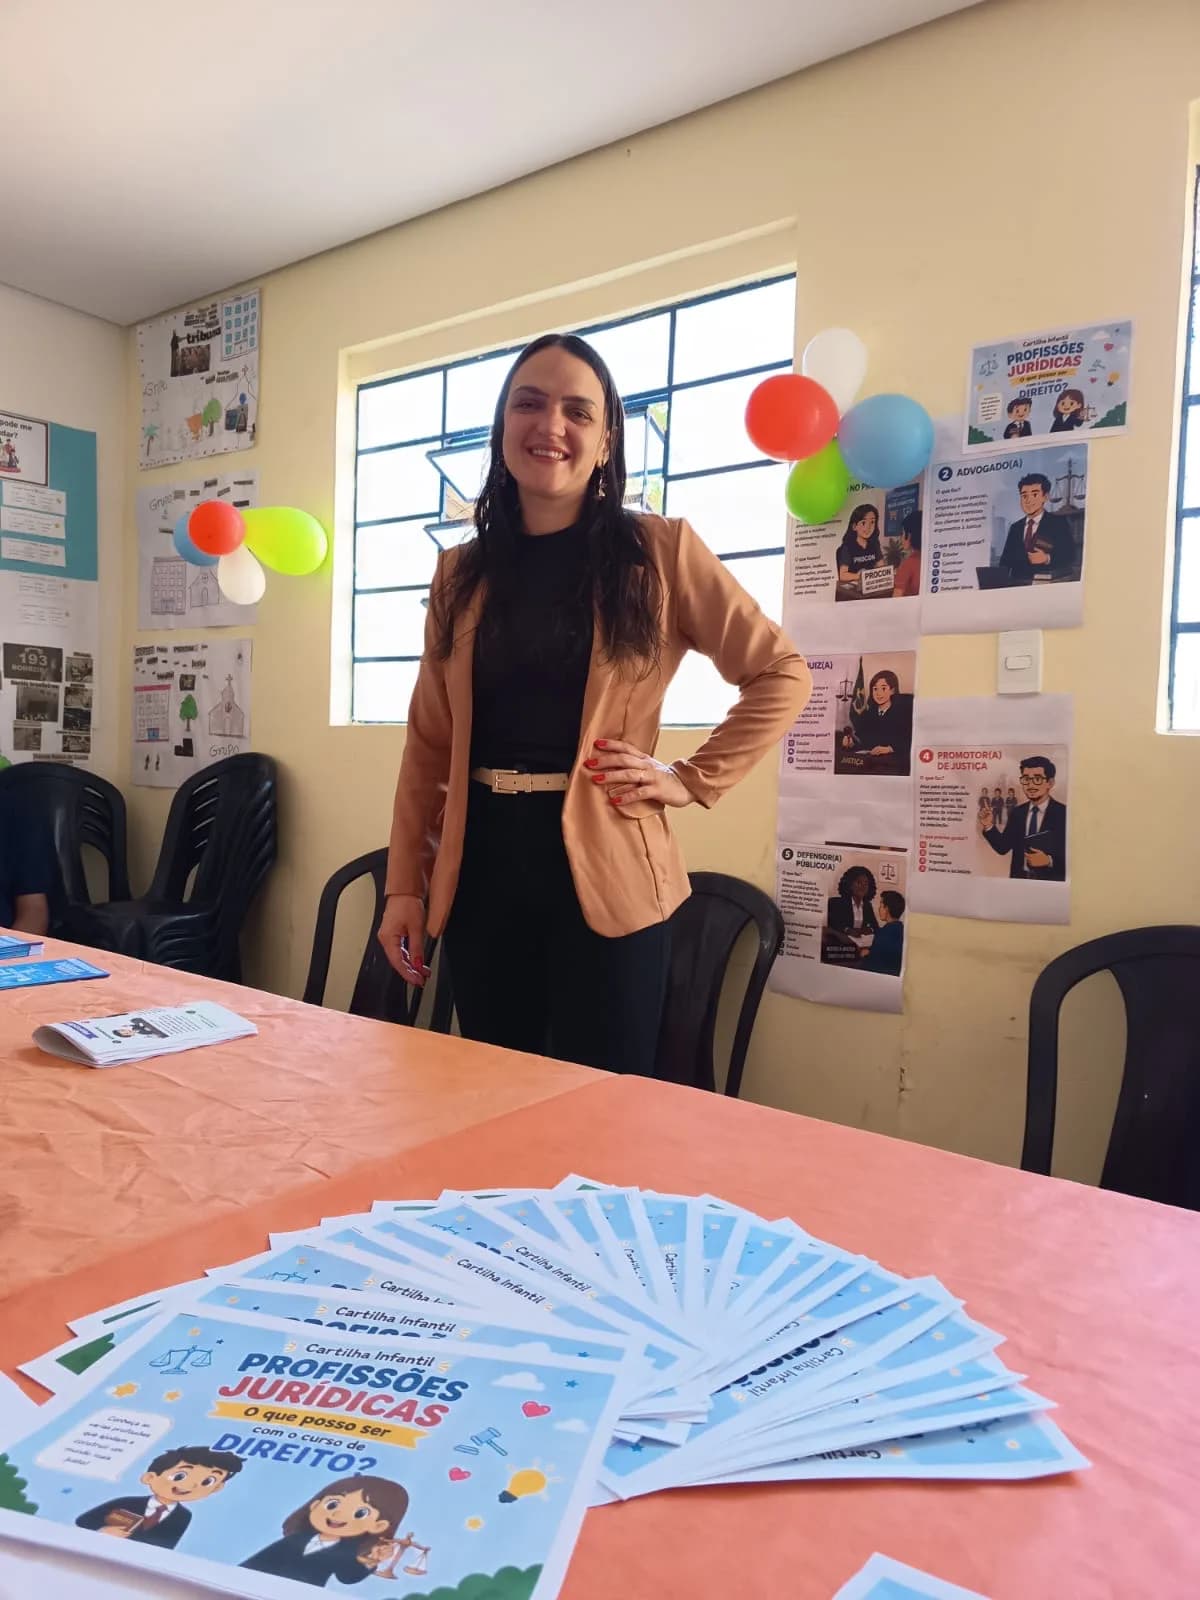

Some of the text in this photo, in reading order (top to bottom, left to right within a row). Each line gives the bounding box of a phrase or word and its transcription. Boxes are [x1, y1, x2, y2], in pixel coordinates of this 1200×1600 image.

[1007, 341, 1085, 366] PROFISSÕES
[1007, 355, 1082, 377] JURÍDICAS
[1019, 382, 1069, 399] DIREITO?
[956, 458, 1023, 477] ADVOGADO(A)
[865, 569, 891, 580] PROCON
[937, 751, 1002, 761] PROMOTOR(A)
[937, 762, 988, 771] DE JUSTIÇA
[796, 860, 836, 871] PÚBLICO(A)
[797, 851, 842, 863] DEFENSOR(A)
[457, 1258, 545, 1305] Cartilha Infantil
[515, 1246, 591, 1293] Cartilha Infantil
[380, 1281, 430, 1302] Cartilha
[336, 1306, 396, 1324] Cartilha
[400, 1315, 456, 1333] Infantil
[306, 1343, 435, 1368] Cartilha Infantil
[793, 1347, 844, 1372] Cartilha
[237, 1352, 469, 1402] PROFISSÕES
[750, 1366, 798, 1397] Infantil
[218, 1376, 450, 1427] JURÍDICAS
[244, 1407, 392, 1438] O que posso ser
[252, 1426, 366, 1452] com o curso de
[211, 1433, 377, 1476] DIREITO?
